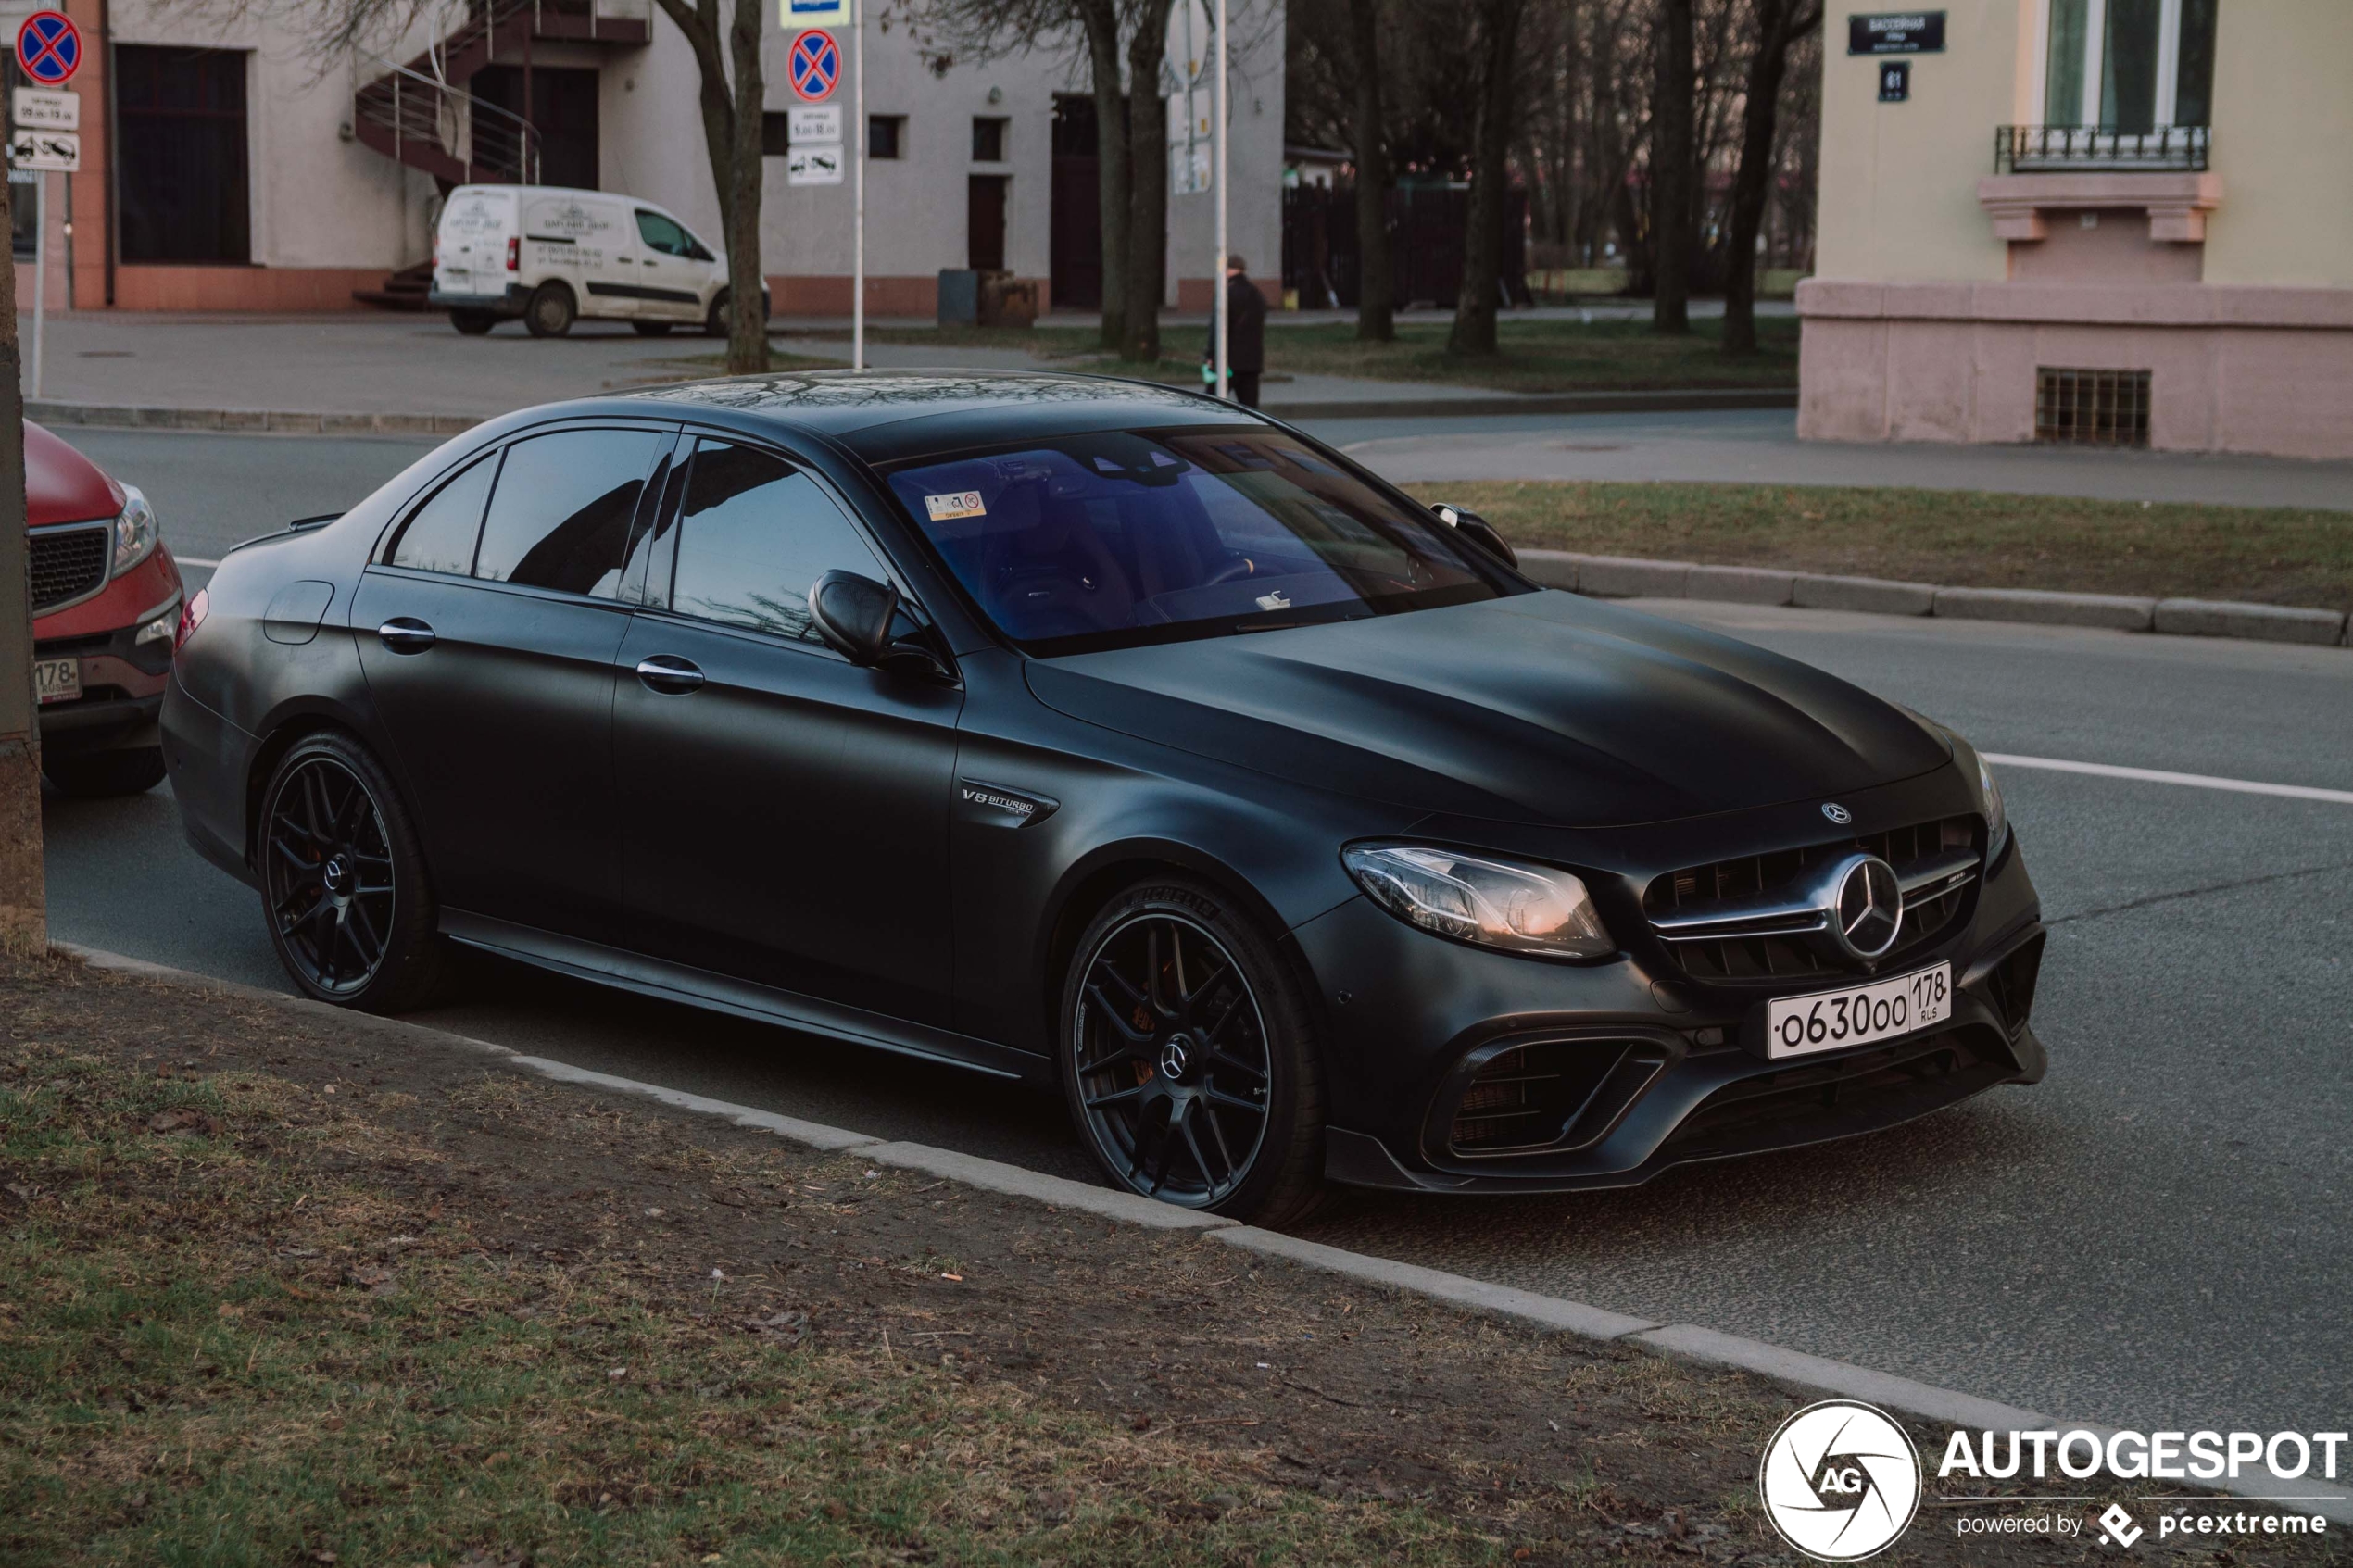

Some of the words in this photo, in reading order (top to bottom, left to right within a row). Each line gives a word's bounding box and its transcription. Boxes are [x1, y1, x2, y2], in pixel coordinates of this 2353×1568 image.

[1869, 16, 1926, 31] БАССЕЙНАЯ
[35, 661, 70, 686] 178
[43, 683, 61, 694] RUS
[963, 788, 988, 804] V8
[988, 795, 1034, 812] BITURBO
[1130, 886, 1216, 917] MICHELIN
[1912, 971, 1944, 1010] 178
[1920, 1007, 1938, 1022] RUS
